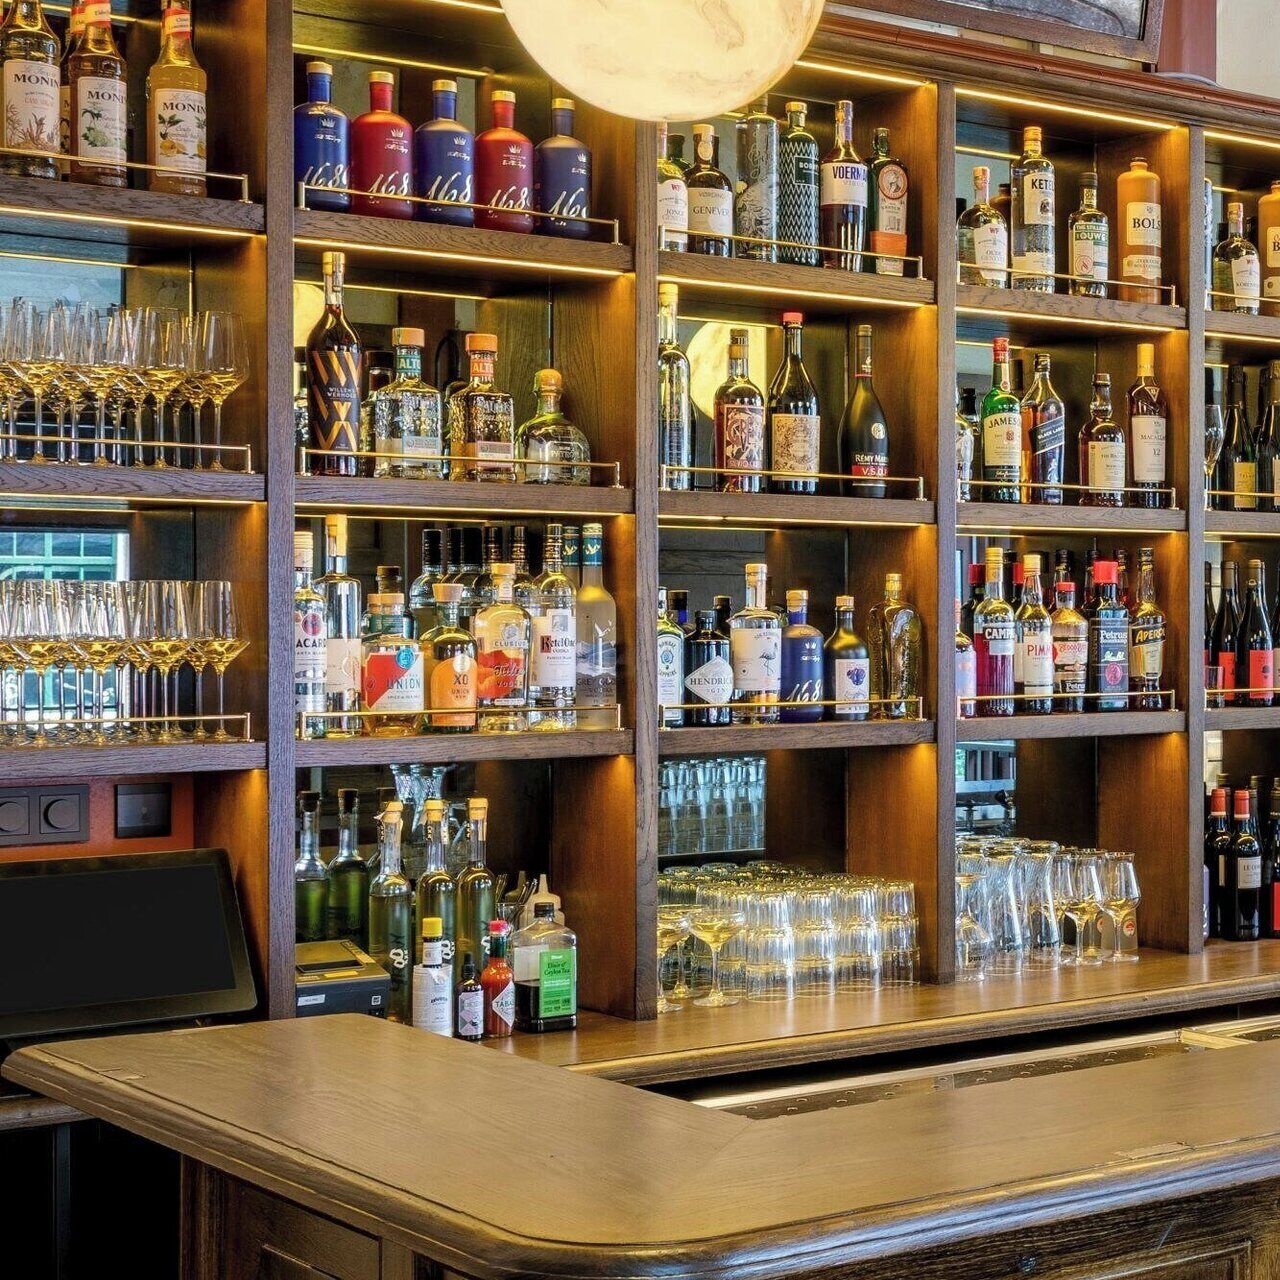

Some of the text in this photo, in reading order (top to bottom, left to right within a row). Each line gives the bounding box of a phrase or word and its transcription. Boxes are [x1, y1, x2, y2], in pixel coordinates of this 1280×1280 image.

[1132, 217, 1160, 230] BOLS
[1100, 629, 1127, 640] Petrus
[453, 674, 469, 686] XO
